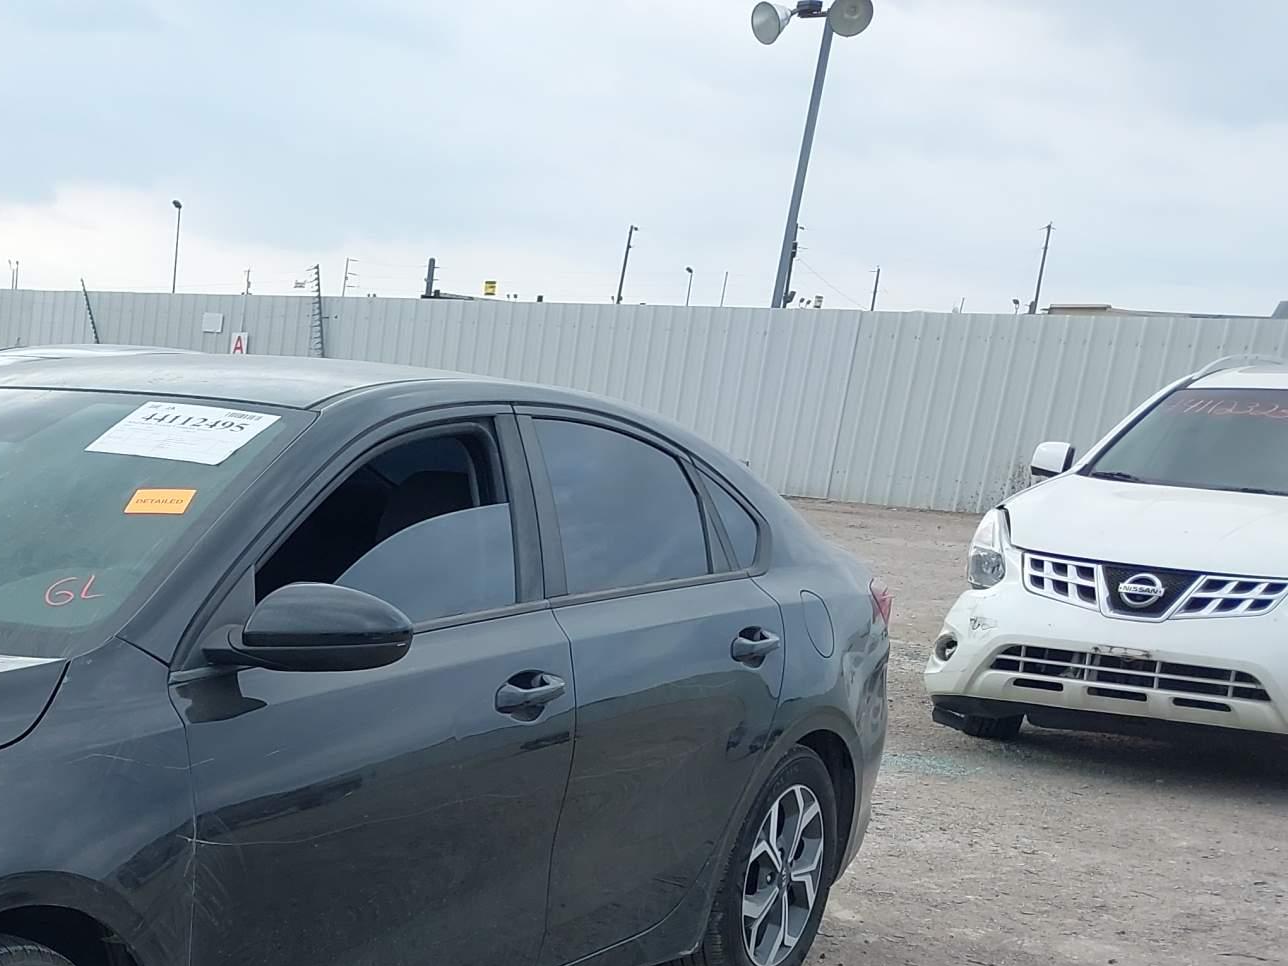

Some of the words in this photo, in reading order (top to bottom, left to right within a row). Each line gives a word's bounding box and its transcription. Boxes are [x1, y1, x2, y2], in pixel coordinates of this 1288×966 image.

[232, 335, 244, 355] A
[141, 412, 250, 433] 44112495
[135, 498, 185, 506] DETAILED
[1122, 585, 1158, 594] NISSAN
